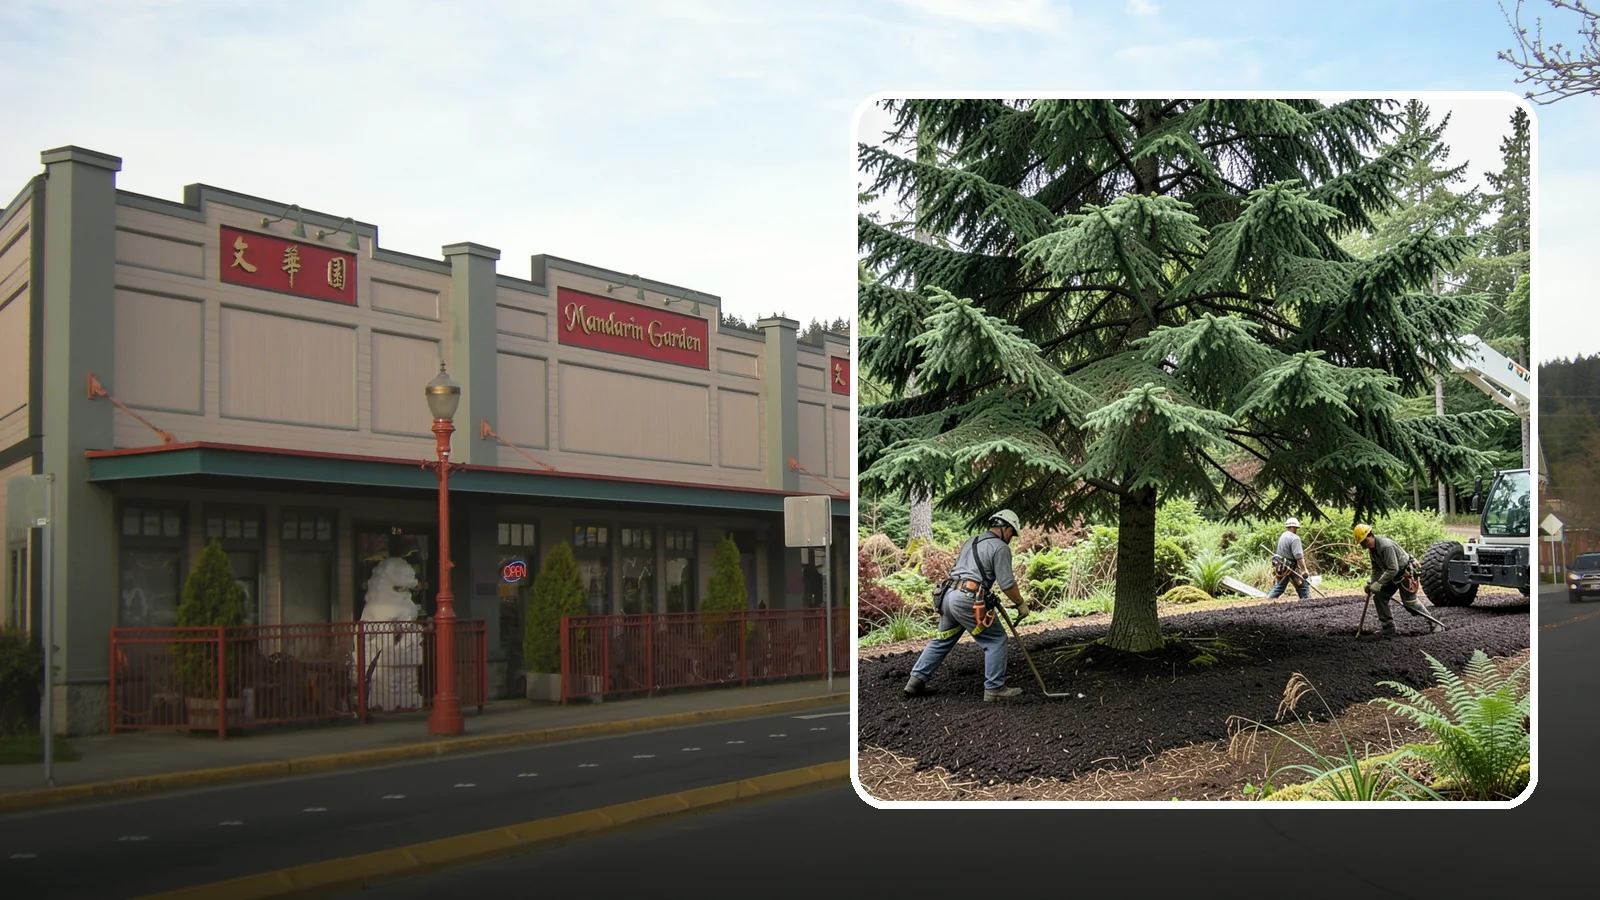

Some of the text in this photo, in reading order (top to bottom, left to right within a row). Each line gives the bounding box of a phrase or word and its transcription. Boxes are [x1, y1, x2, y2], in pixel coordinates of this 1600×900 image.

[231, 236, 346, 290] 文華園
[564, 302, 702, 352] Mandarin Garden
[503, 565, 527, 578] OPEN
